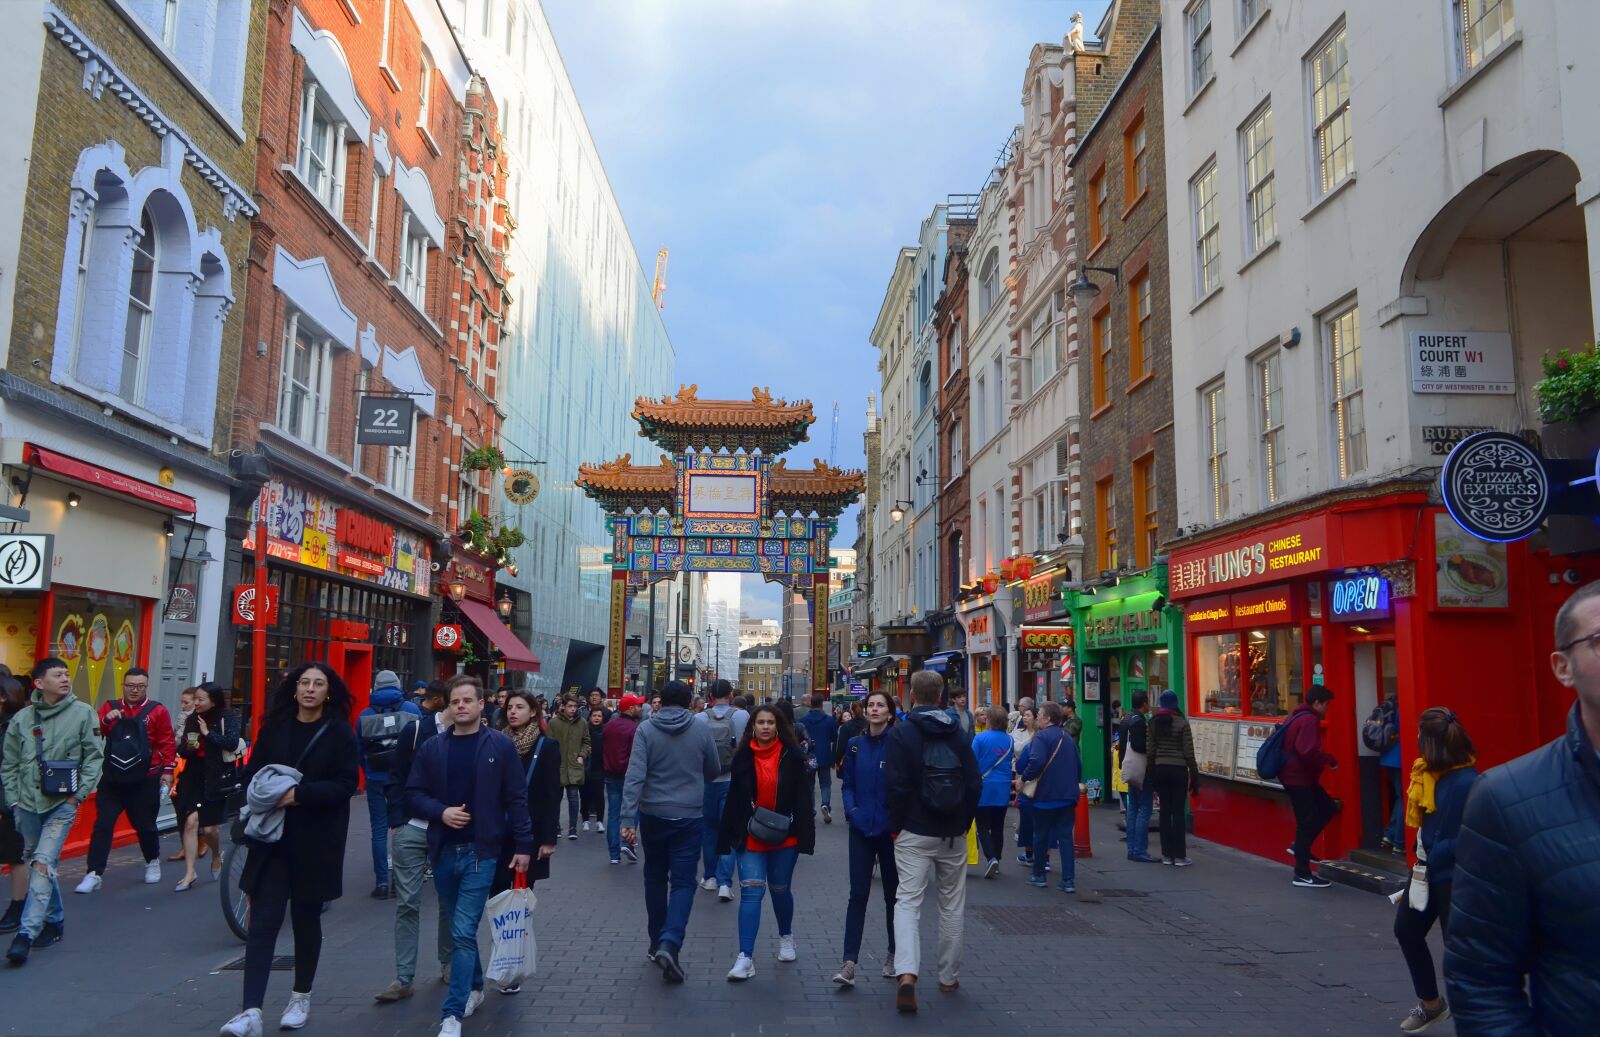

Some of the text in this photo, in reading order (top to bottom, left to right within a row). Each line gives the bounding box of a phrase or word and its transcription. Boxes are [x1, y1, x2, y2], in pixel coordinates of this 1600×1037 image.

[1419, 335, 1467, 348] RUPERT
[1419, 350, 1483, 363] COURT W1
[1421, 383, 1434, 391] CITY
[372, 408, 399, 427] 22
[1475, 472, 1522, 483] PIZZA
[1463, 484, 1537, 495] EXPRESS
[335, 508, 393, 556] ICHIBUNS
[1268, 534, 1302, 553] CHINESE
[1208, 542, 1266, 583] HUNG'S
[1269, 547, 1321, 570] RESTAURANT
[1265, 598, 1287, 612] Chinois
[1333, 577, 1380, 614] OPEN
[1095, 609, 1162, 635] EASY HEALTH
